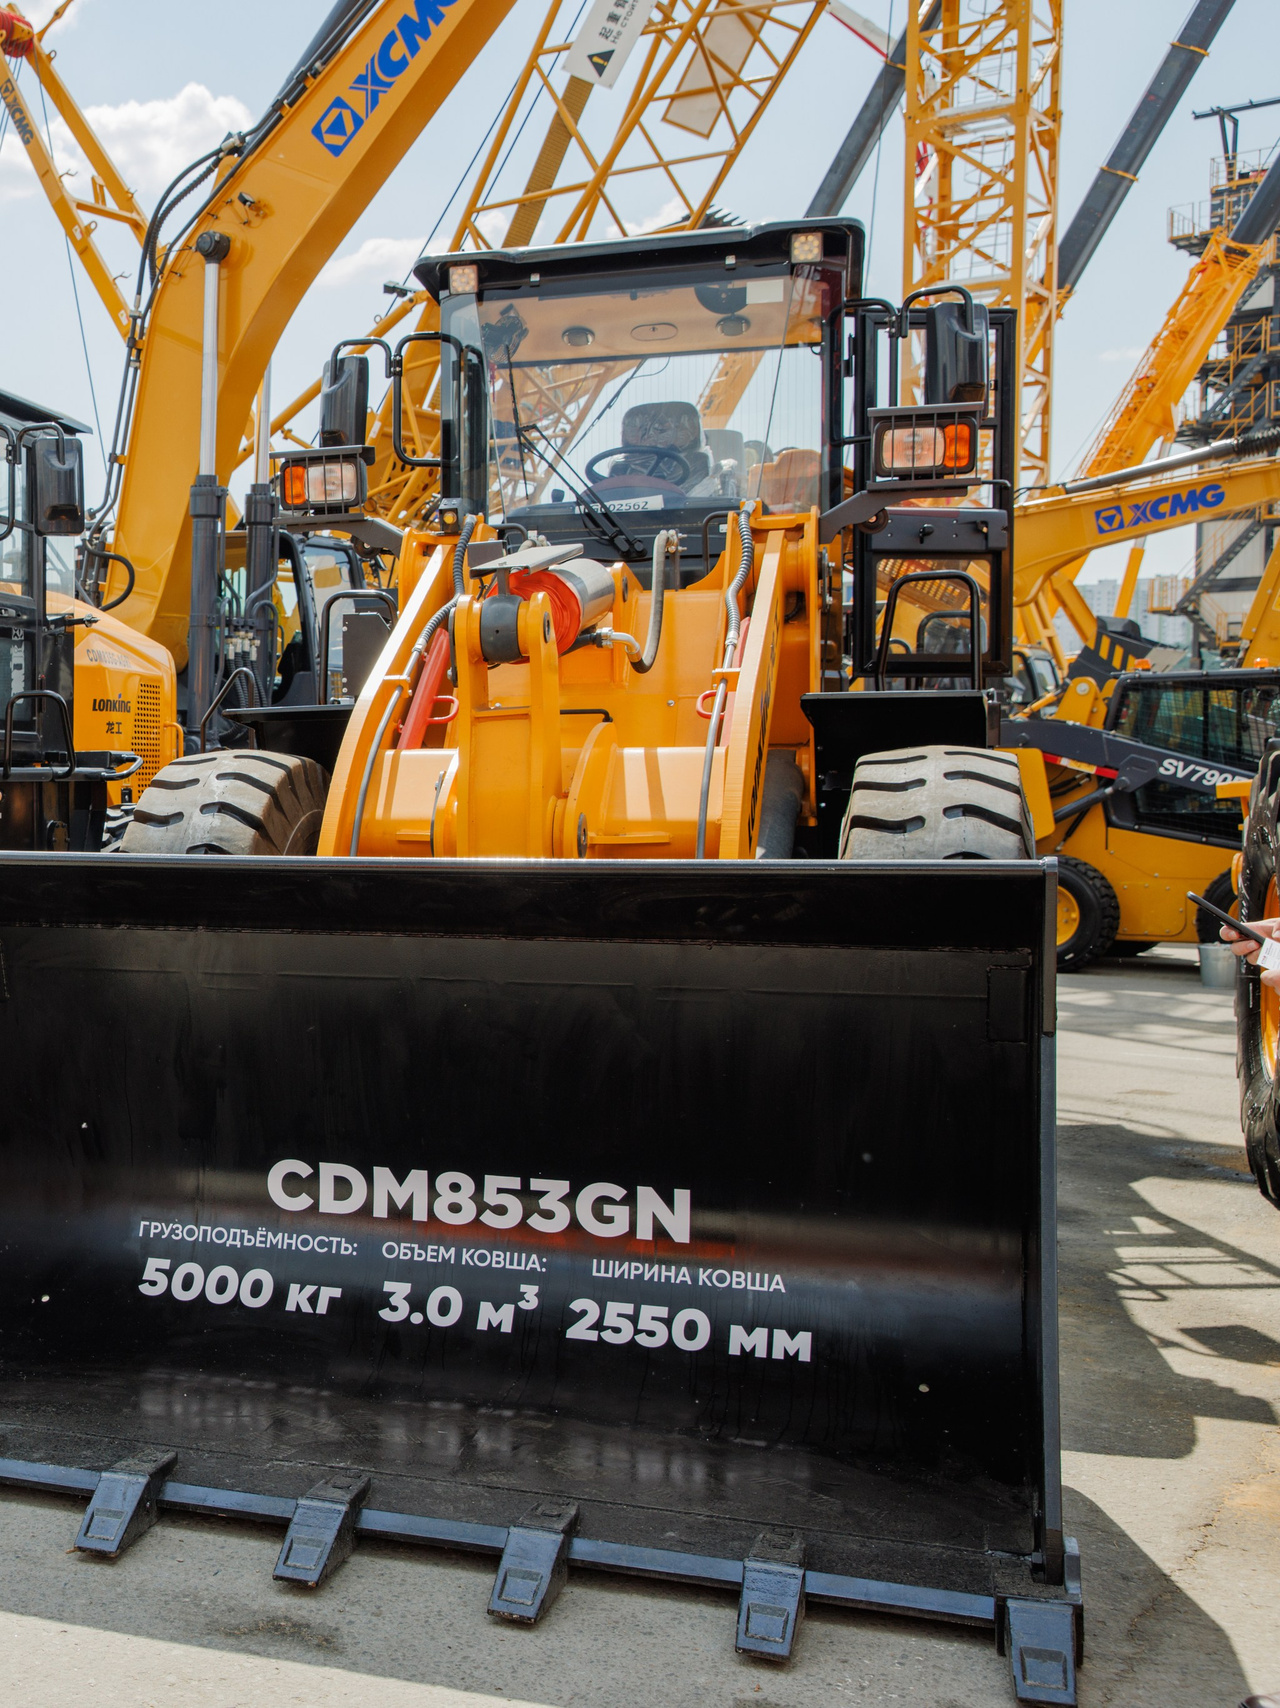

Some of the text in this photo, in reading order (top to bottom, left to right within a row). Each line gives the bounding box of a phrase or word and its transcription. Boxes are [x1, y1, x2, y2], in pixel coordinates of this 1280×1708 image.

[348, 0, 459, 121] XCM
[6, 94, 34, 146] XCMG
[1126, 484, 1225, 528] XCMG
[1159, 758, 1246, 786] SV790
[267, 1158, 691, 1244] CDM853GN
[138, 1220, 359, 1257] ГРУЗОПОДЪЁМНОСТЬ:
[381, 1241, 547, 1273] ОБЪЕМ КОВША:
[138, 1257, 343, 1315] 5000 кг
[592, 1258, 786, 1293] ШИРИНА КОВША
[378, 1280, 463, 1328] 3.0
[565, 1298, 813, 1363] 2550 мм
